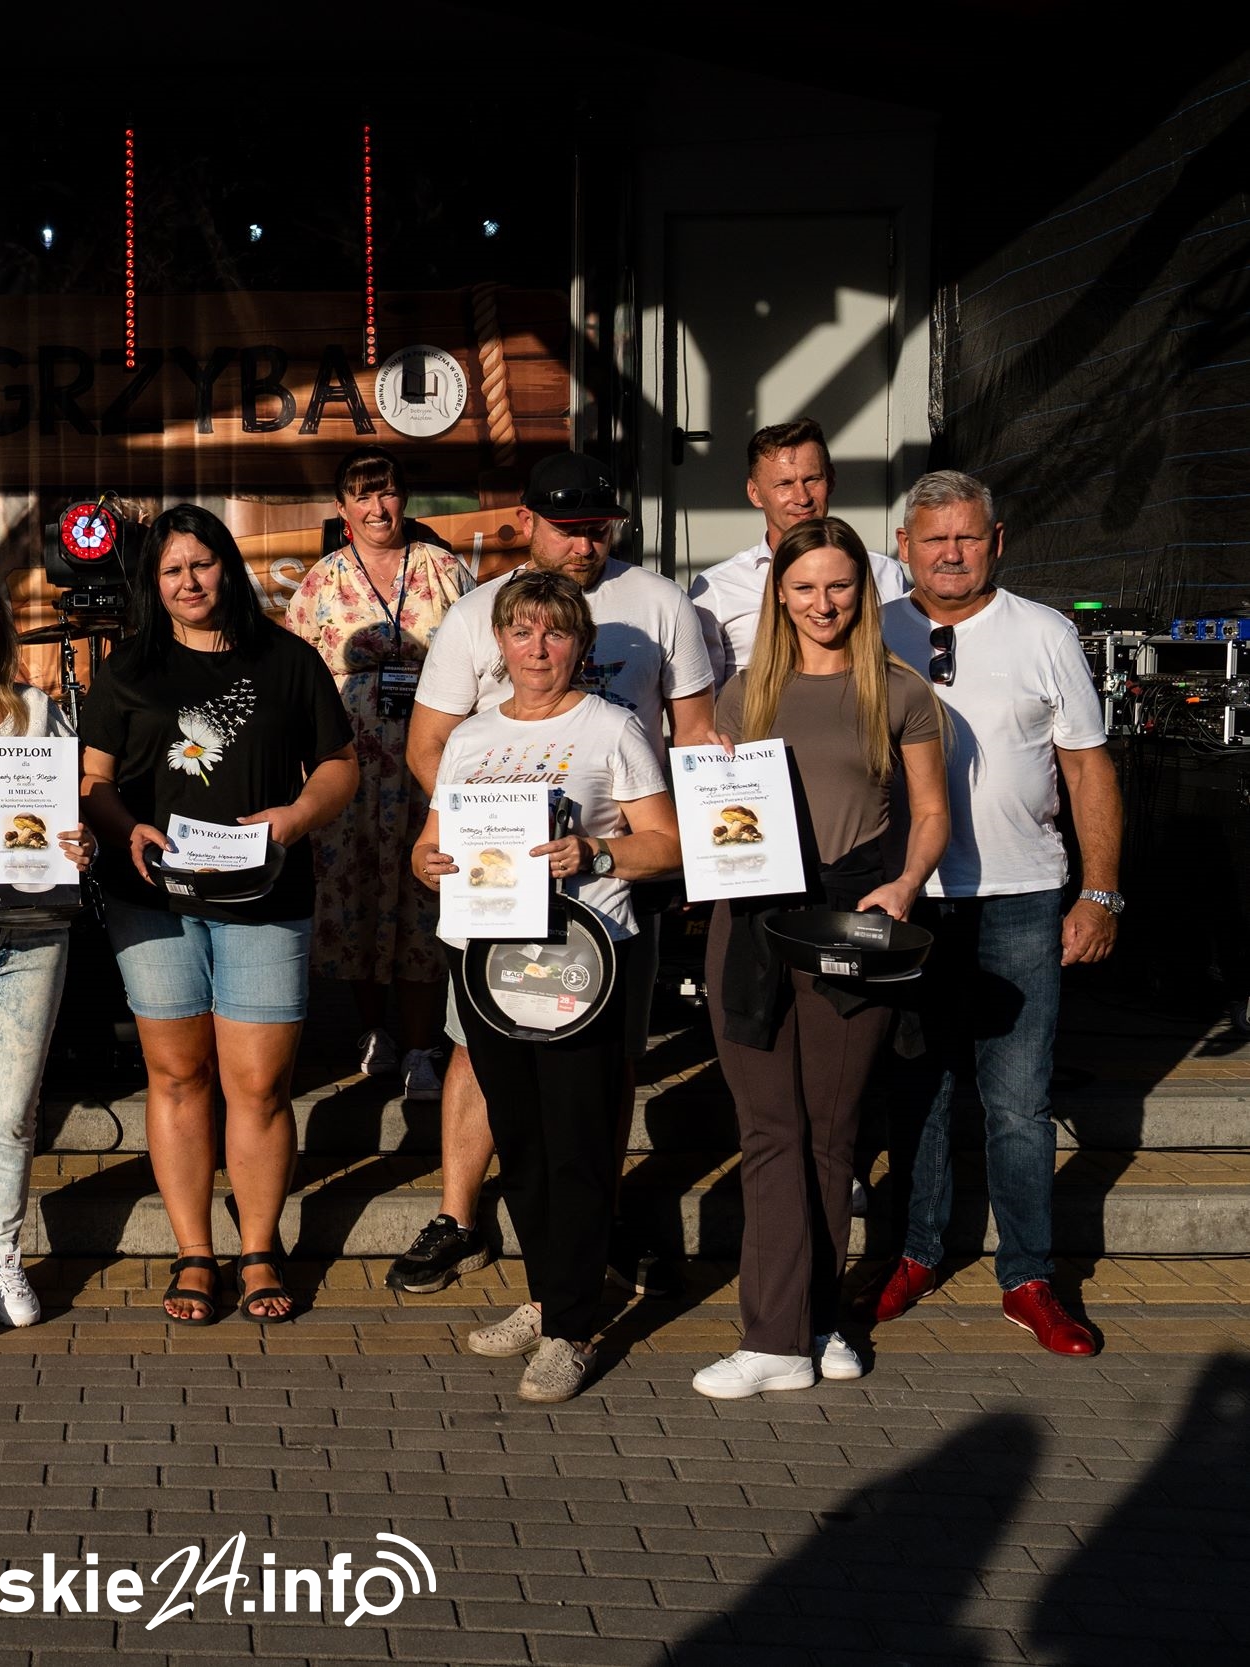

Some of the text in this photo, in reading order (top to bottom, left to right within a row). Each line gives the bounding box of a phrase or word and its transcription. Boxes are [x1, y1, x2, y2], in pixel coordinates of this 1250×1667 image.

[413, 350, 450, 367] PUBLICZNA
[454, 372, 464, 412] OSIECZNEJ
[697, 750, 775, 763] WYRÓŻNIENIE
[463, 792, 538, 803] WYRÓŻNIENIE
[191, 828, 260, 840] WYRÓŻNIENIE
[569, 971, 578, 984] 3
